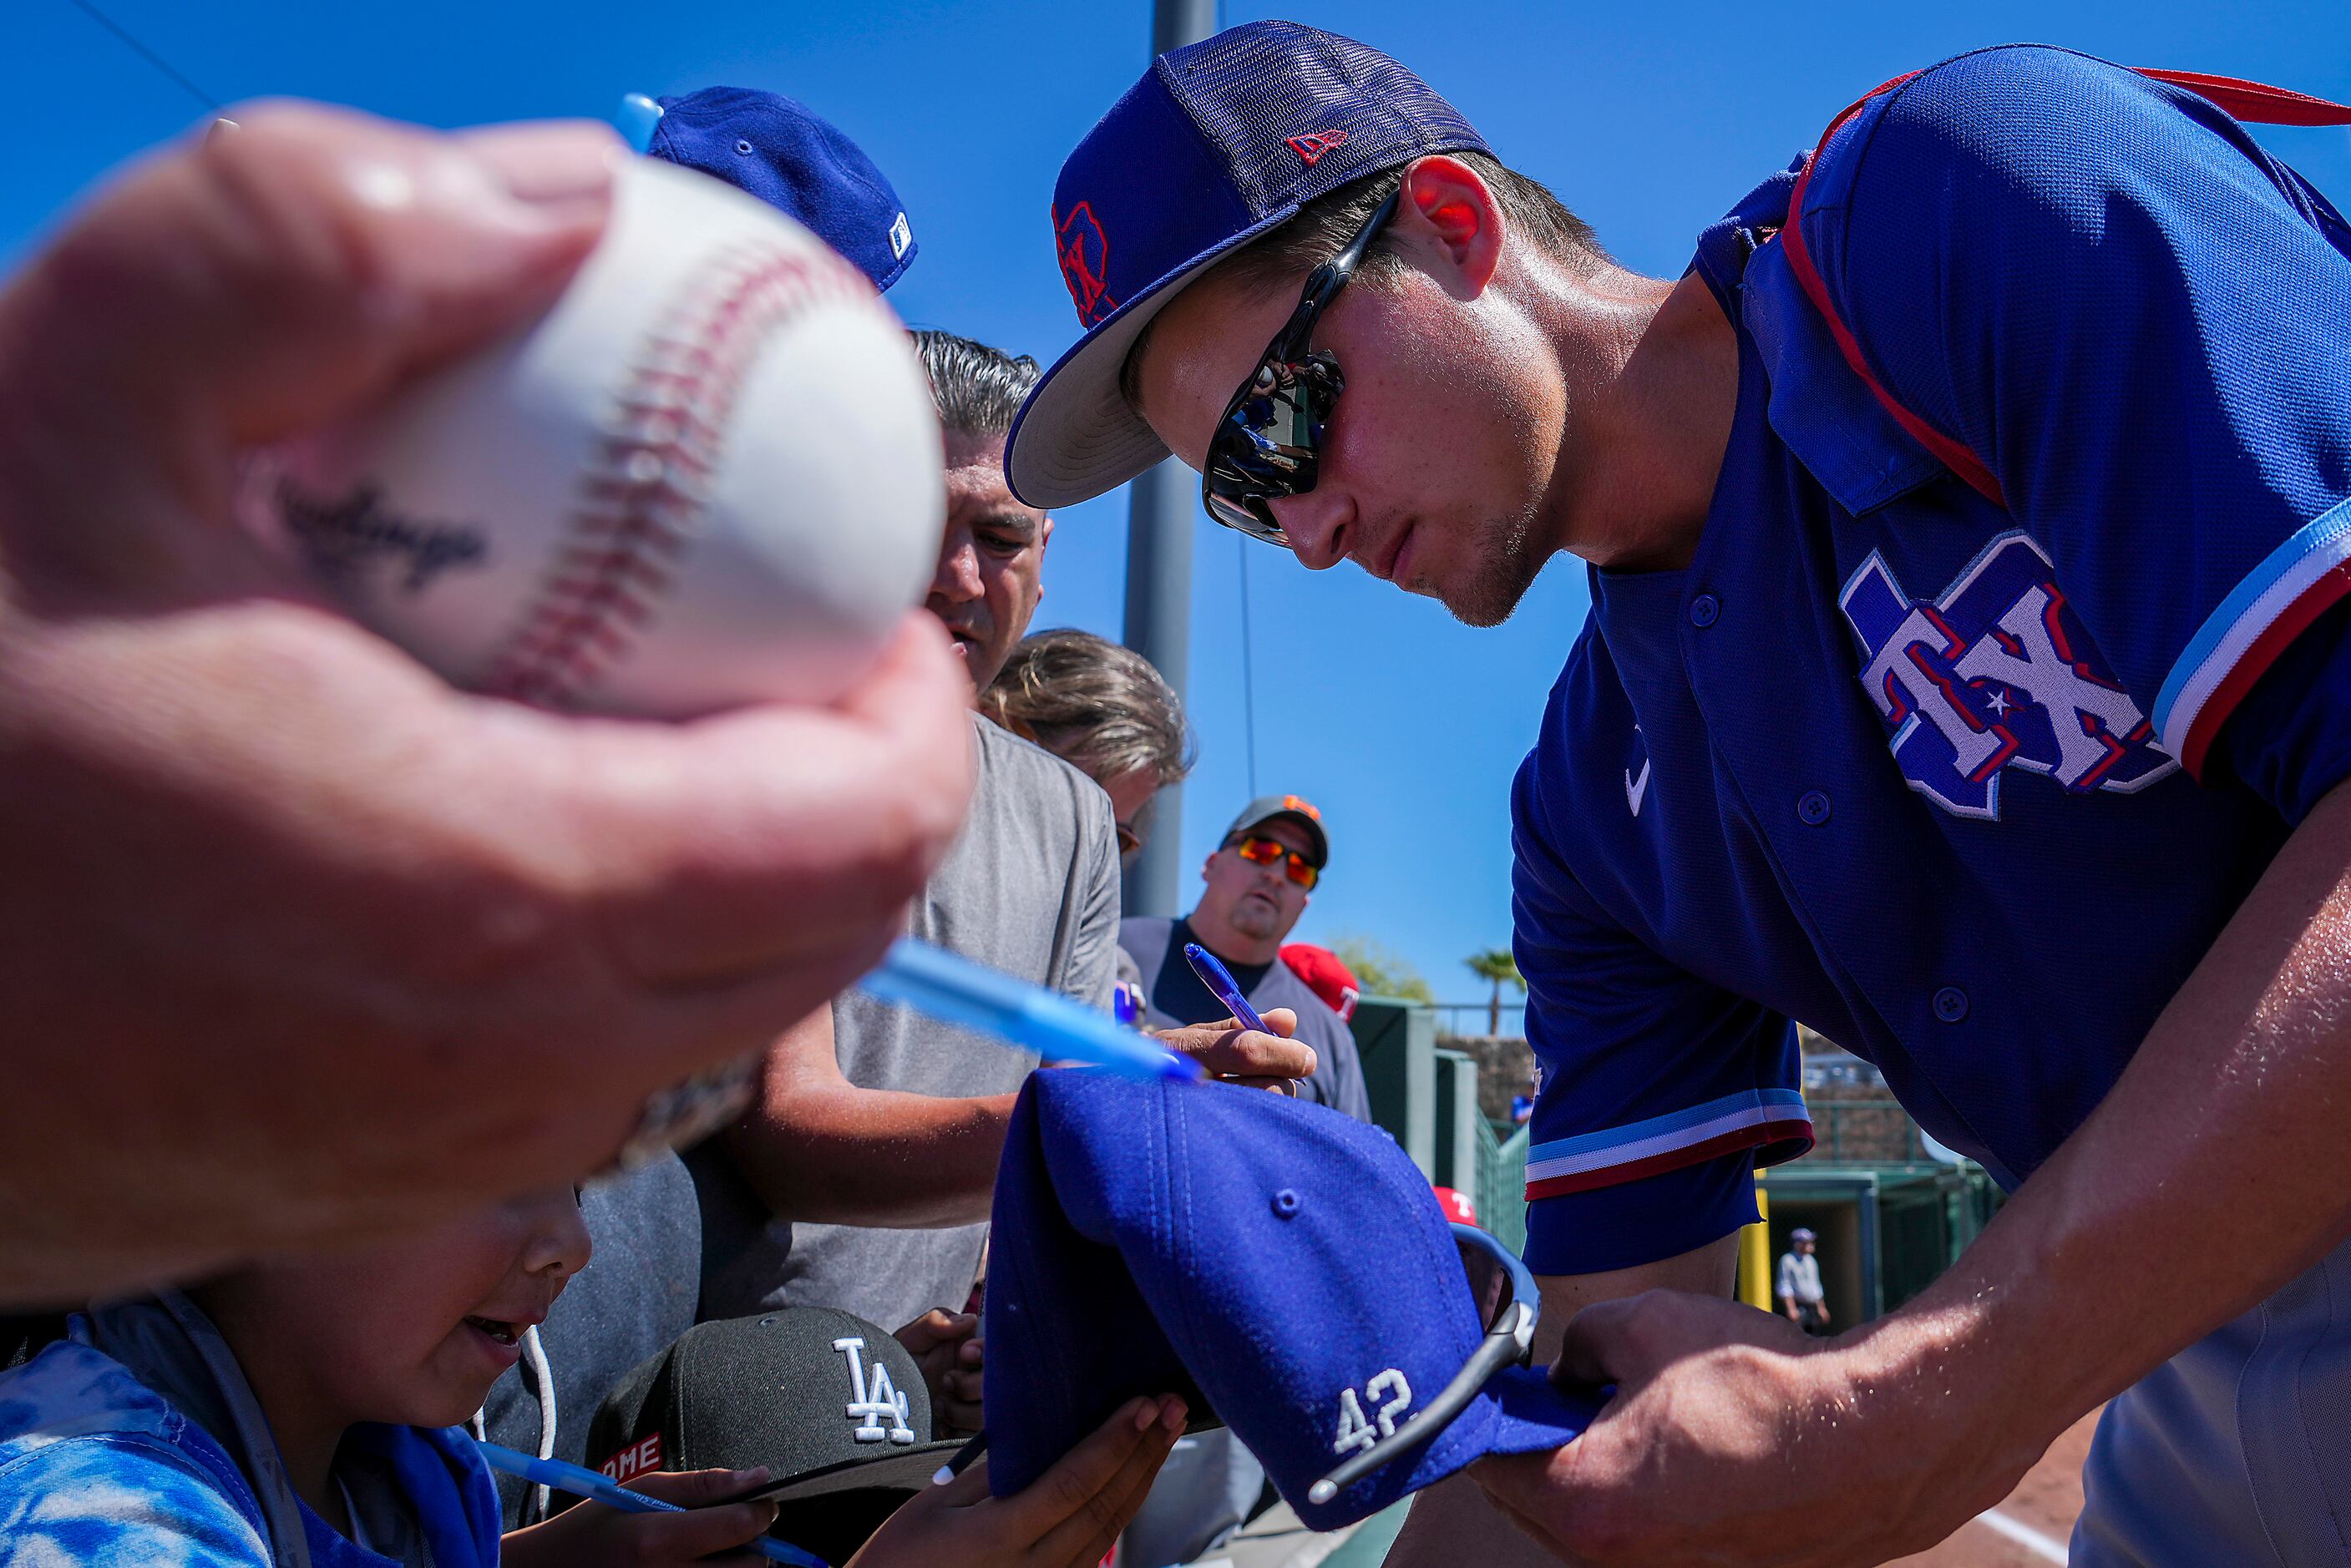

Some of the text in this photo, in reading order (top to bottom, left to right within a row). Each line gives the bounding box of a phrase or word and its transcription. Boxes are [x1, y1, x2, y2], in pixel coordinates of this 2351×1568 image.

[1859, 583, 2152, 787] TX
[1451, 1191, 1472, 1218] T
[832, 1337, 915, 1444] LA
[1334, 1367, 1419, 1455] 42
